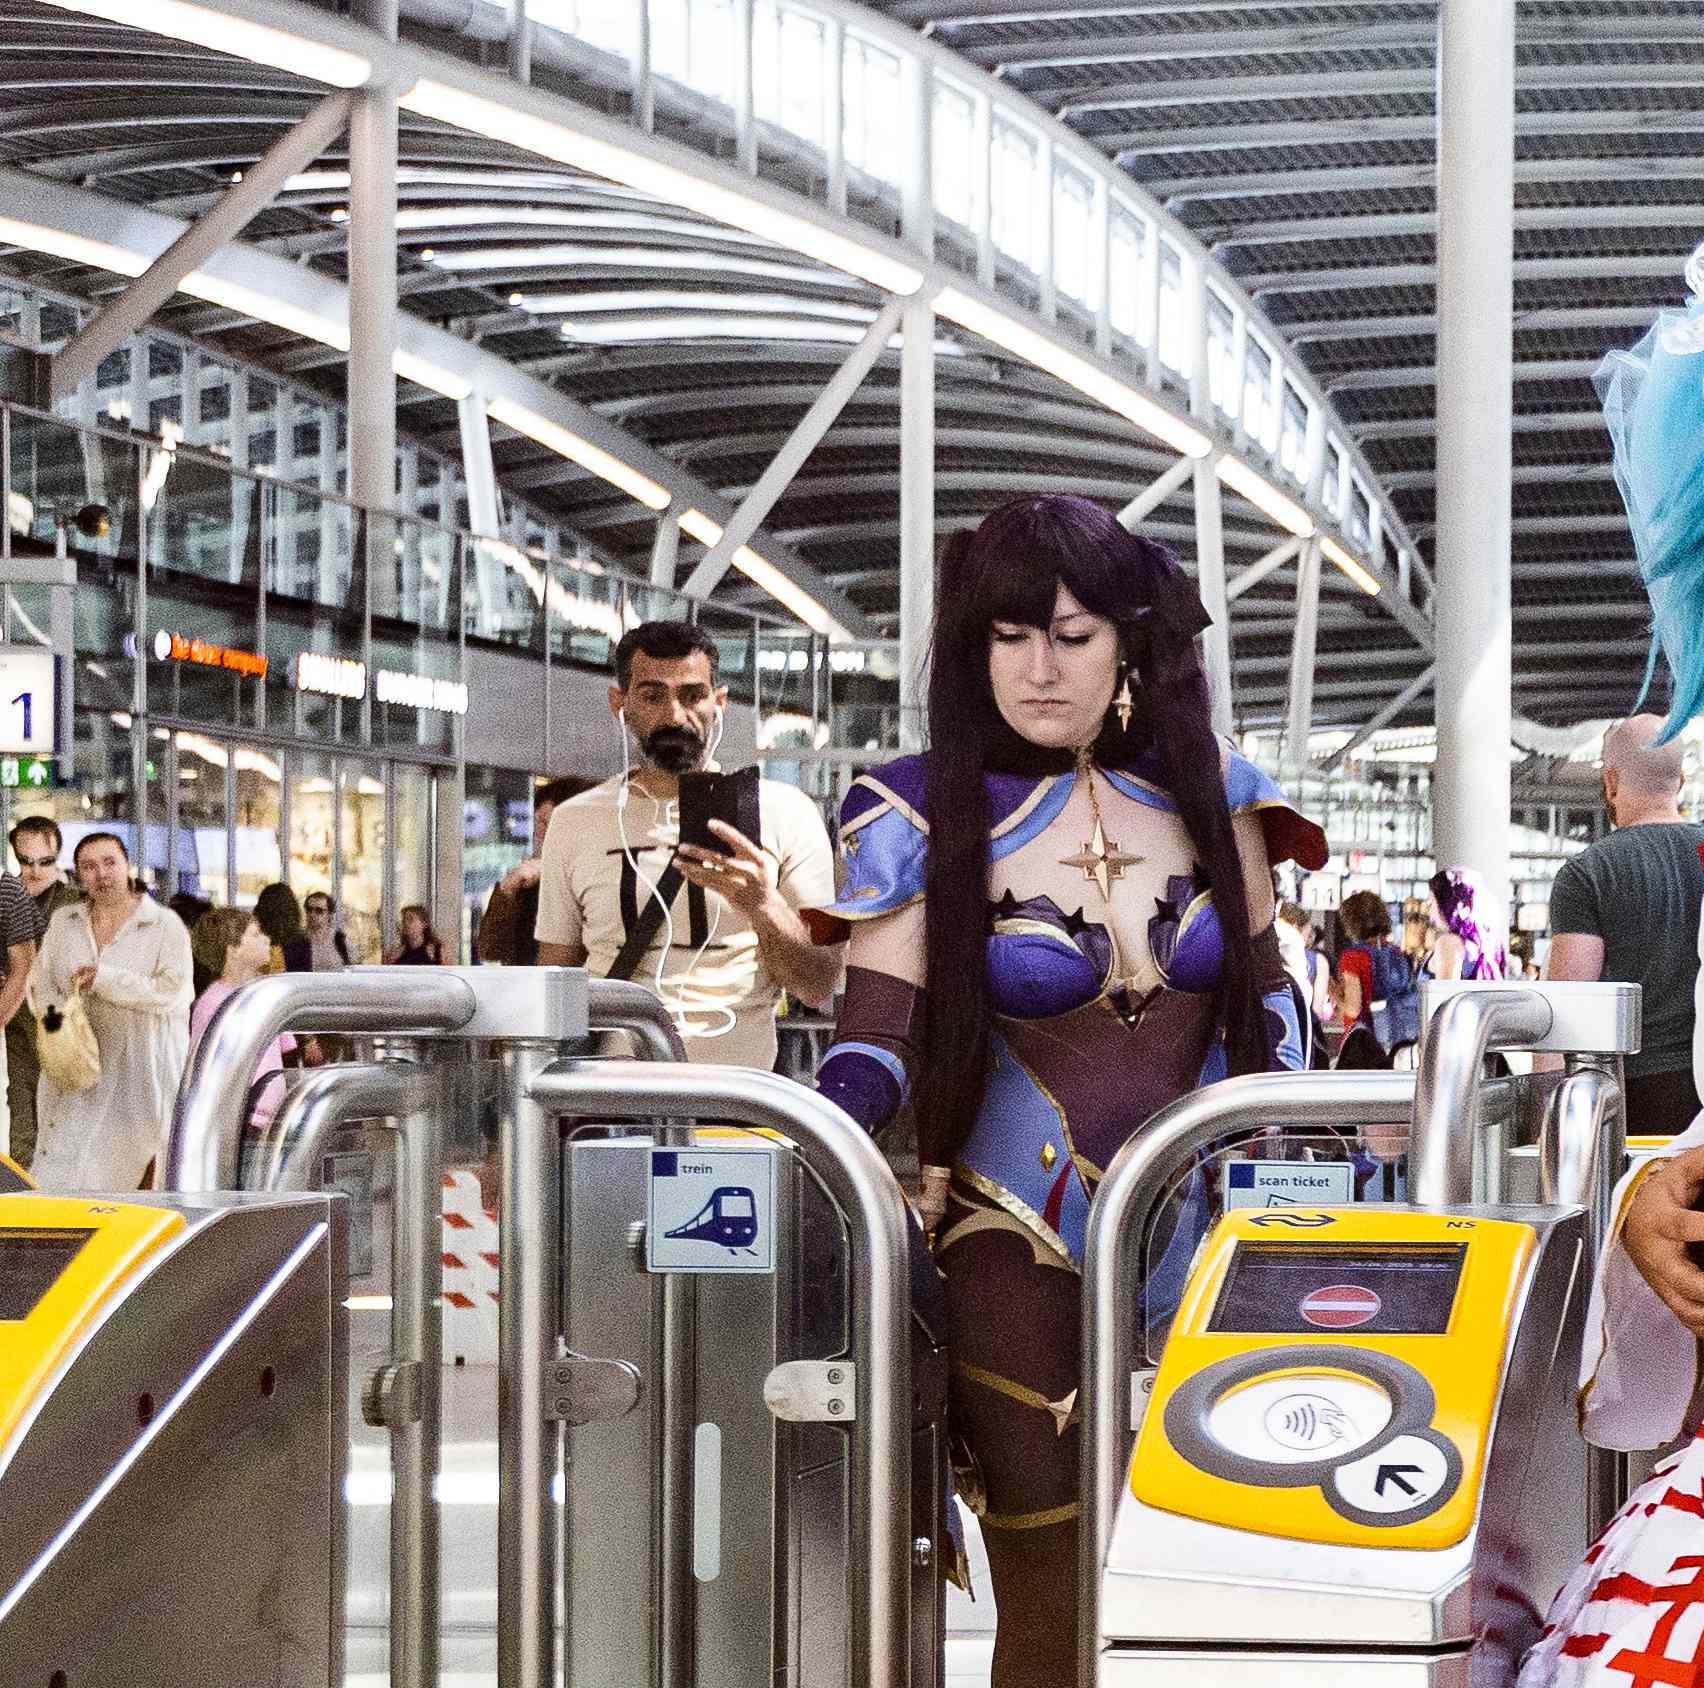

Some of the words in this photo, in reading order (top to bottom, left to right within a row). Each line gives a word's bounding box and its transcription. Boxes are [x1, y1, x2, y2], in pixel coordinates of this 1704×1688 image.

[681, 1163, 713, 1174] trein
[1259, 1176, 1289, 1186] scan
[1292, 1175, 1330, 1187] ticket
